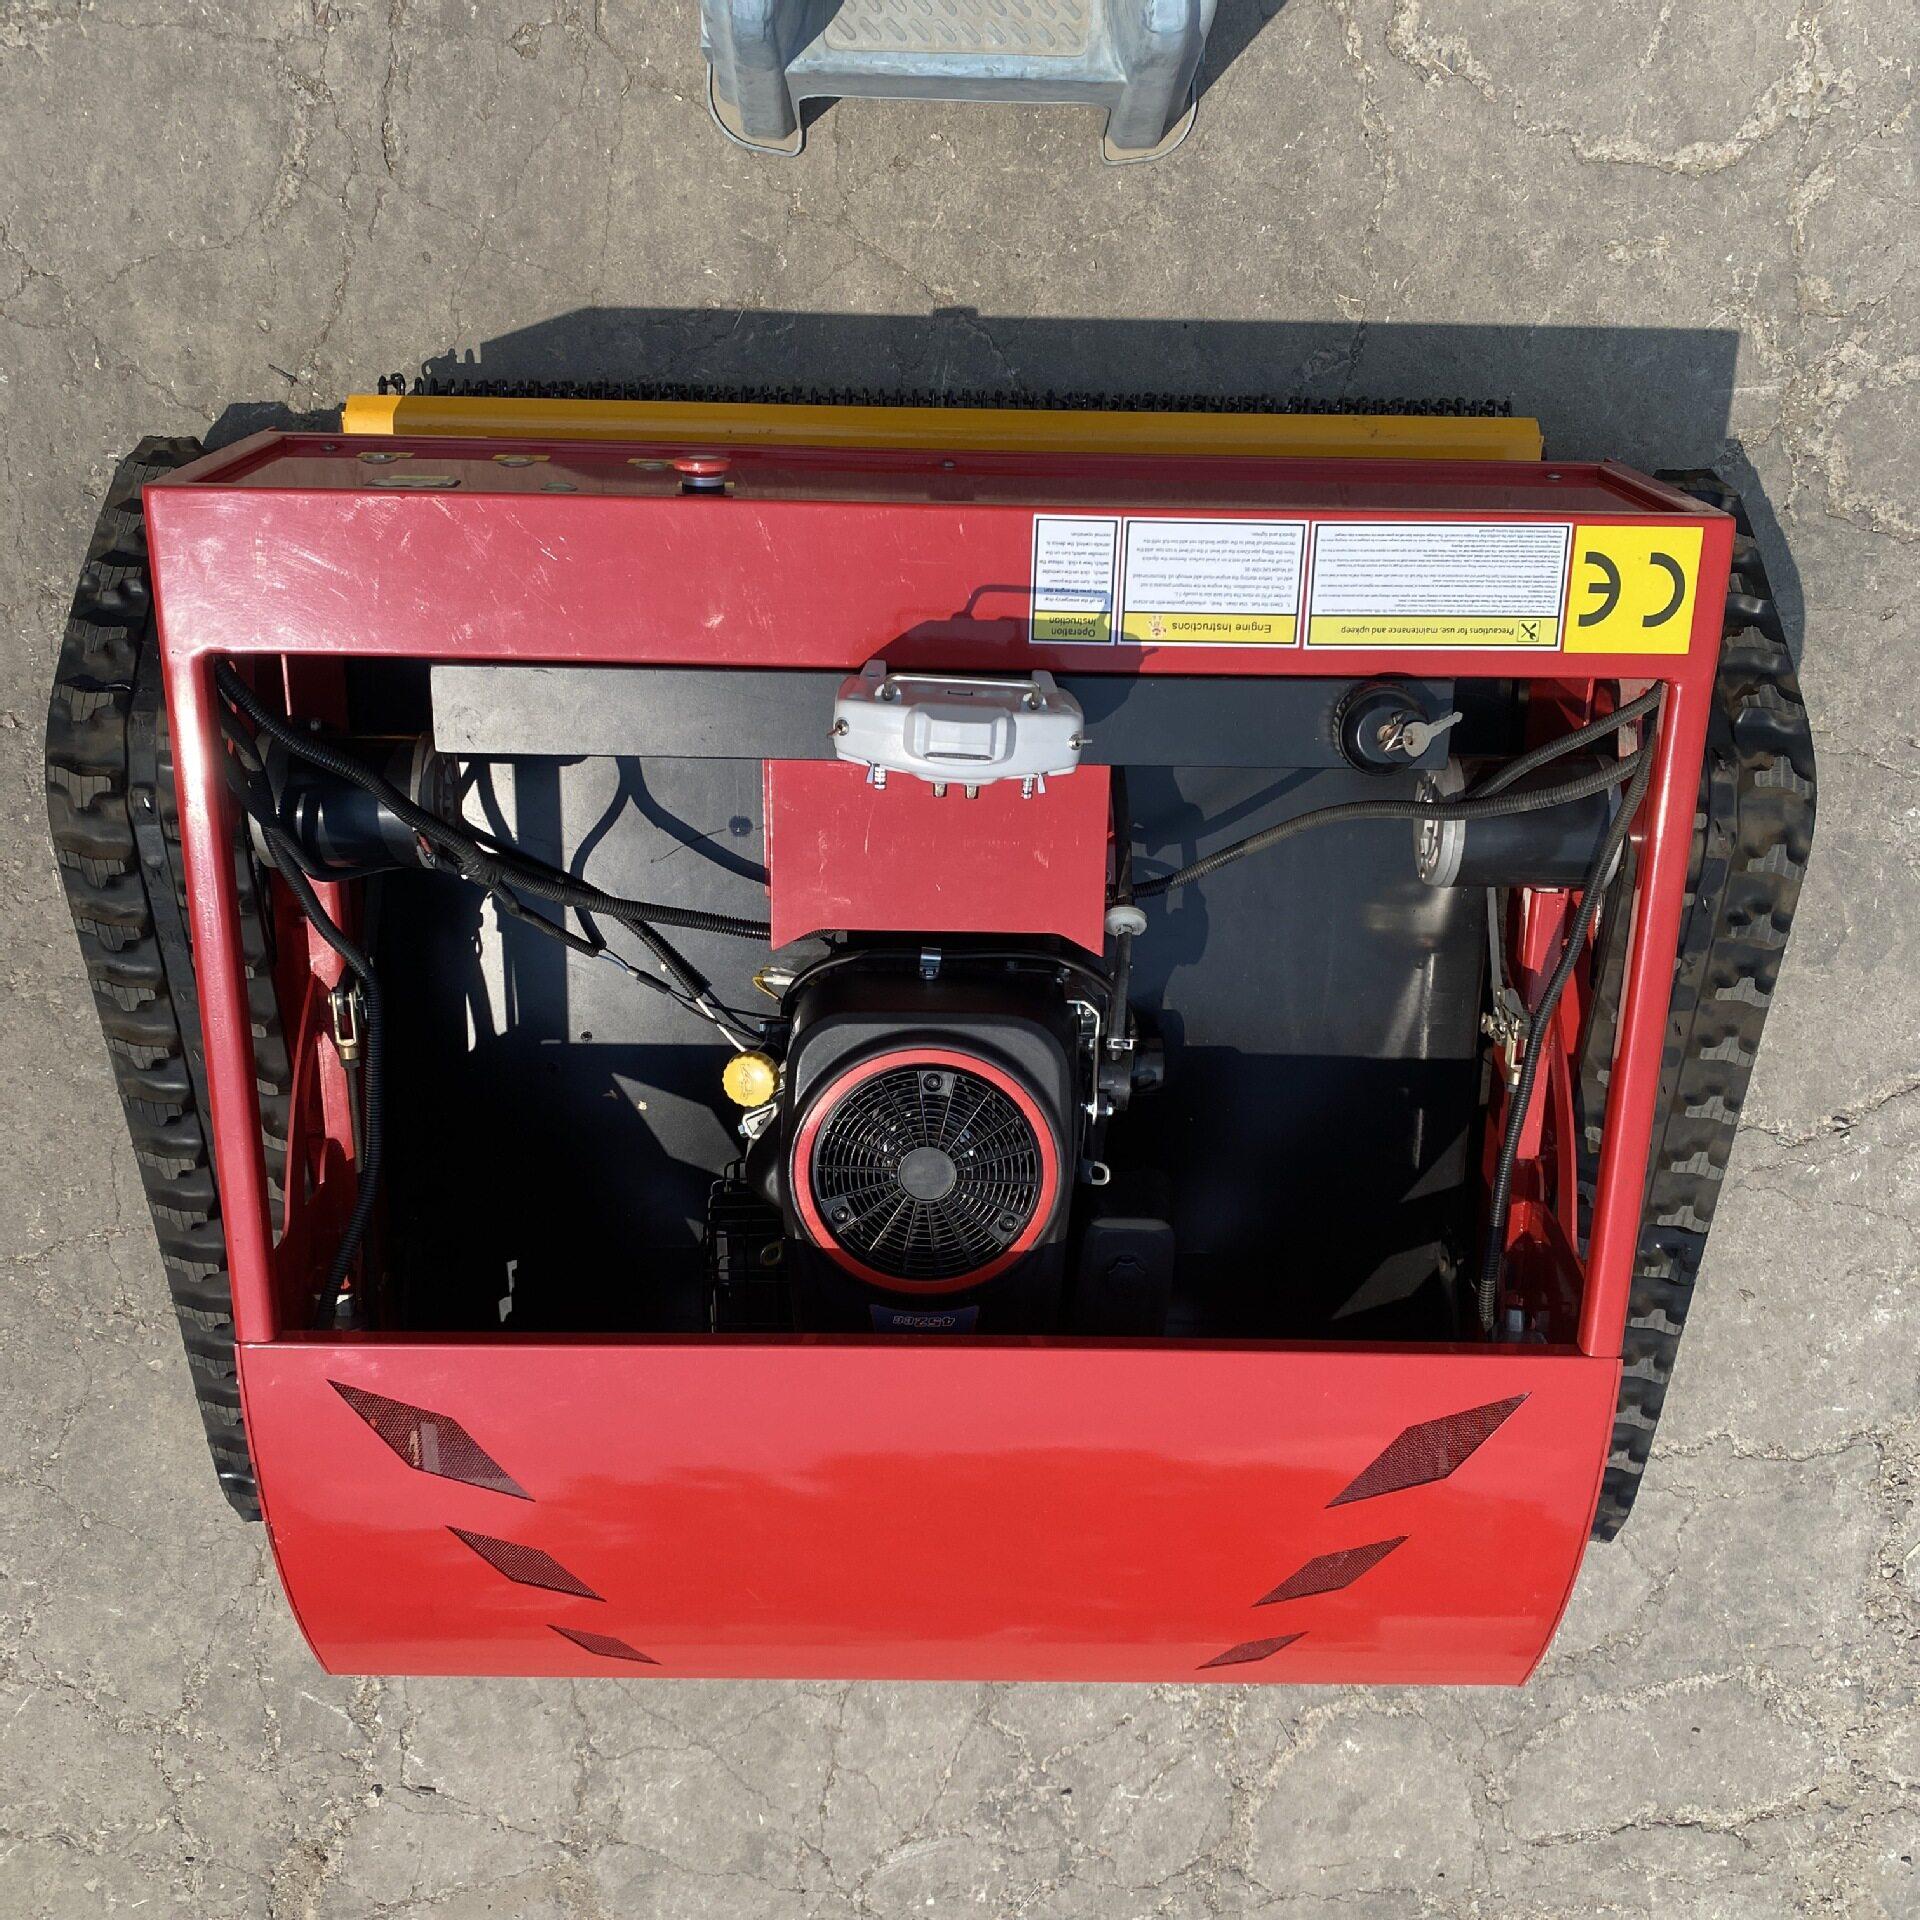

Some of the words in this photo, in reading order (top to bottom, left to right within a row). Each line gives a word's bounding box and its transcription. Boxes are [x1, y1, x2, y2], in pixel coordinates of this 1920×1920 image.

[1578, 551, 1686, 628] CE
[1049, 617, 1096, 626] Instruction
[1172, 622, 1232, 632] Instructions
[1236, 621, 1272, 634] Engine
[1340, 626, 1370, 634] upkeep
[1372, 627, 1386, 635] and
[1388, 627, 1438, 635] maintenance
[1440, 626, 1454, 634] use,
[1456, 626, 1468, 635] for
[1470, 626, 1514, 636] Precautions
[1051, 627, 1096, 638] Operation
